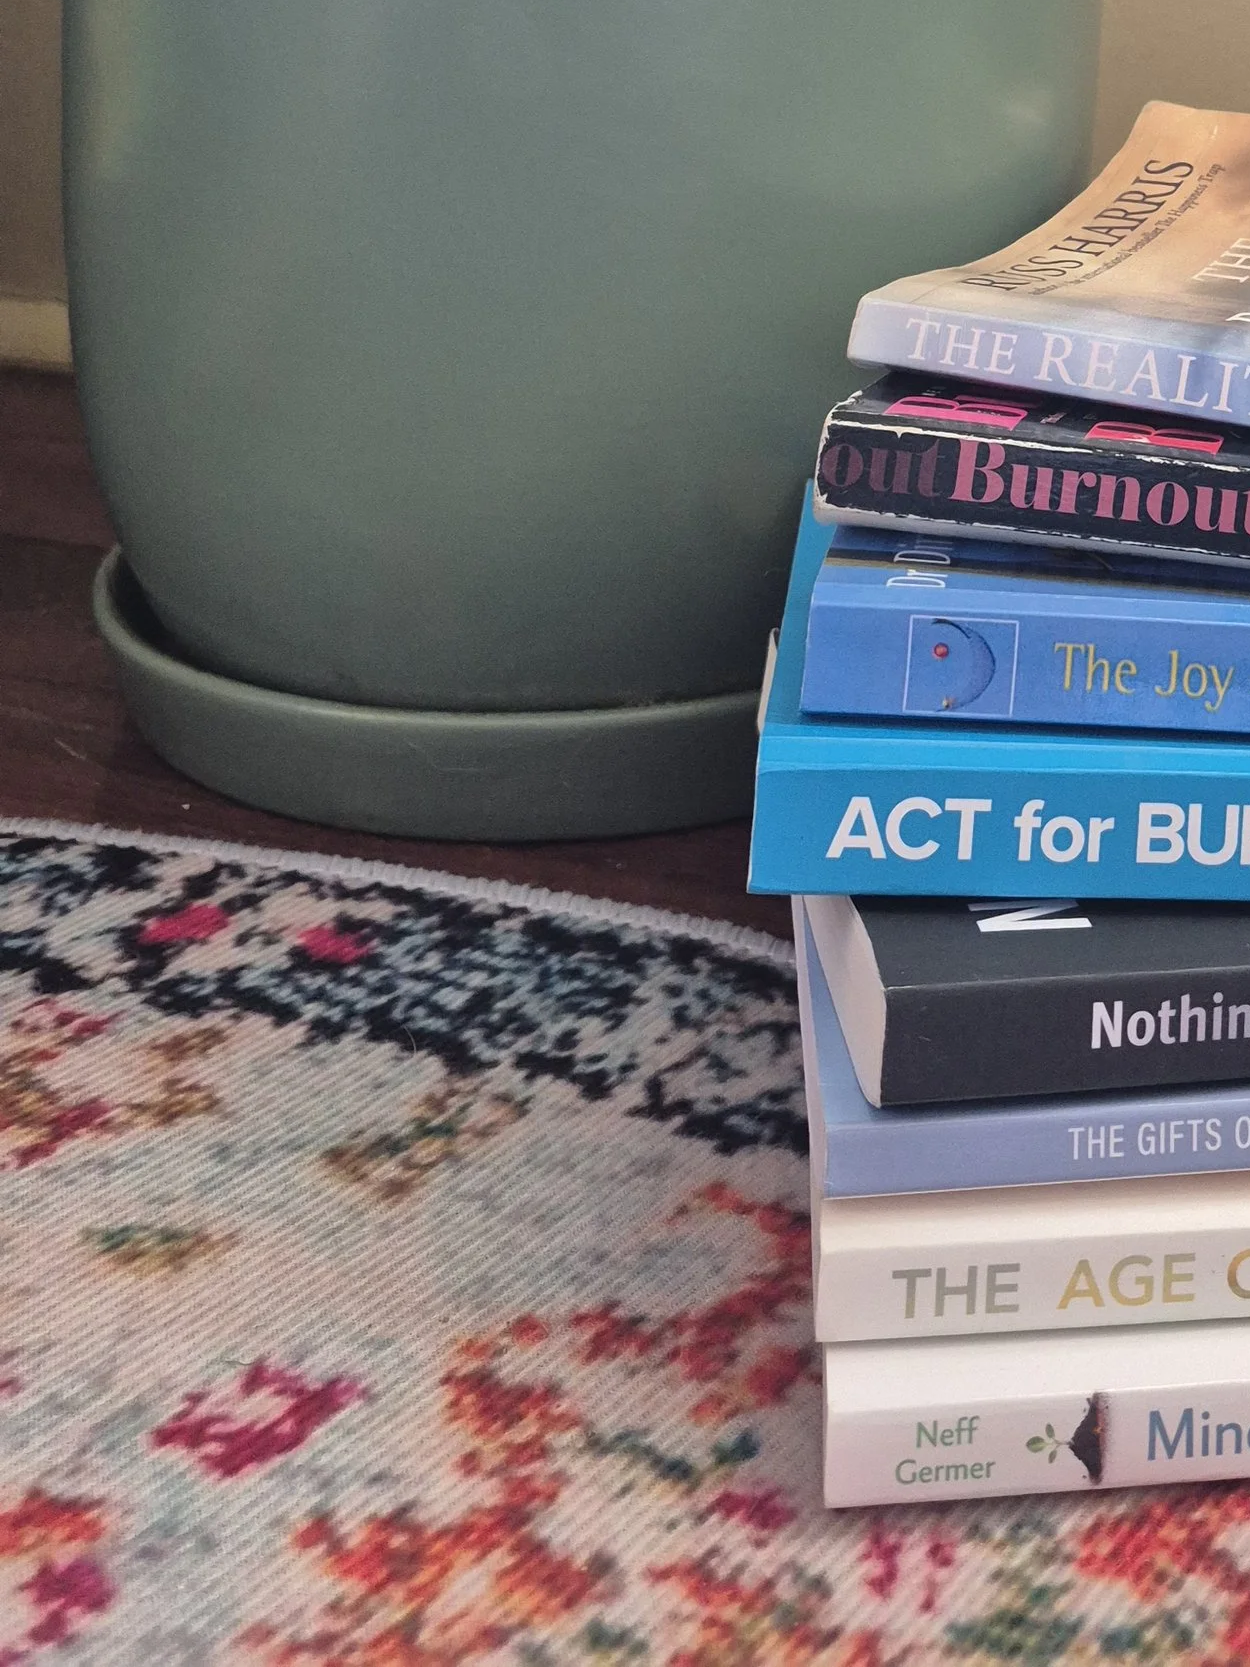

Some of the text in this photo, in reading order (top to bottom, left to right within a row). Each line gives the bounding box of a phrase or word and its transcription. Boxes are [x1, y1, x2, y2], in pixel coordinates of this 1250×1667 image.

[1172, 184, 1208, 216] Happiness
[1198, 163, 1226, 183] Trap
[961, 159, 1195, 291] RUSS HARRIS
[905, 316, 1018, 375] THE
[820, 440, 946, 496] out
[886, 569, 948, 588] Dr
[1053, 642, 1138, 695] The
[1154, 651, 1236, 713] Joy
[825, 796, 992, 861] ACT
[1014, 798, 1115, 863] for
[1068, 1125, 1125, 1161] THE
[1136, 1118, 1222, 1156] GIFTS
[892, 1263, 1021, 1319] THE
[1057, 1253, 1197, 1311] AGE
[915, 1415, 981, 1449] Neff
[895, 1457, 996, 1485] Germer
